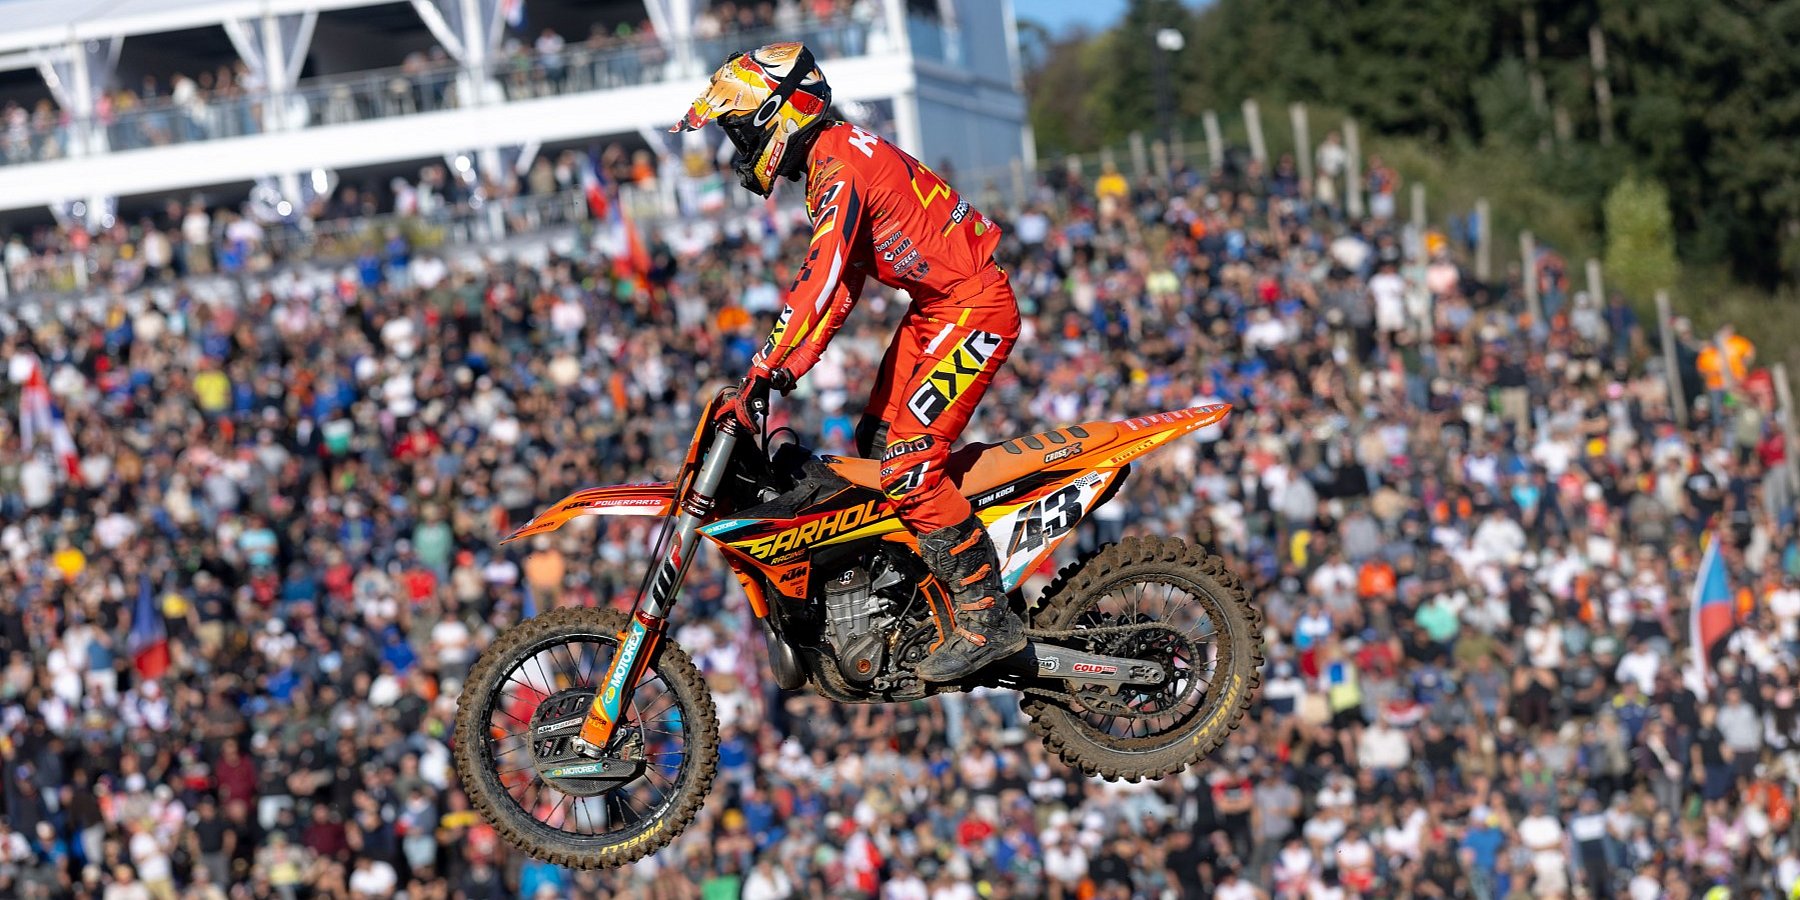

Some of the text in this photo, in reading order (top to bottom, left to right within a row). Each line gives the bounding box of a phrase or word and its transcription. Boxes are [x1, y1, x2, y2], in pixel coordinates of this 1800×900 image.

[907, 329, 1002, 427] FXR
[978, 485, 1016, 507] TOM KOCH
[1006, 484, 1083, 559] 43
[770, 548, 807, 565] RACING
[779, 565, 807, 584] KTM
[610, 624, 643, 689] MOTOREX
[562, 765, 598, 776] MOTOREX
[601, 819, 664, 855] PIRELLI
